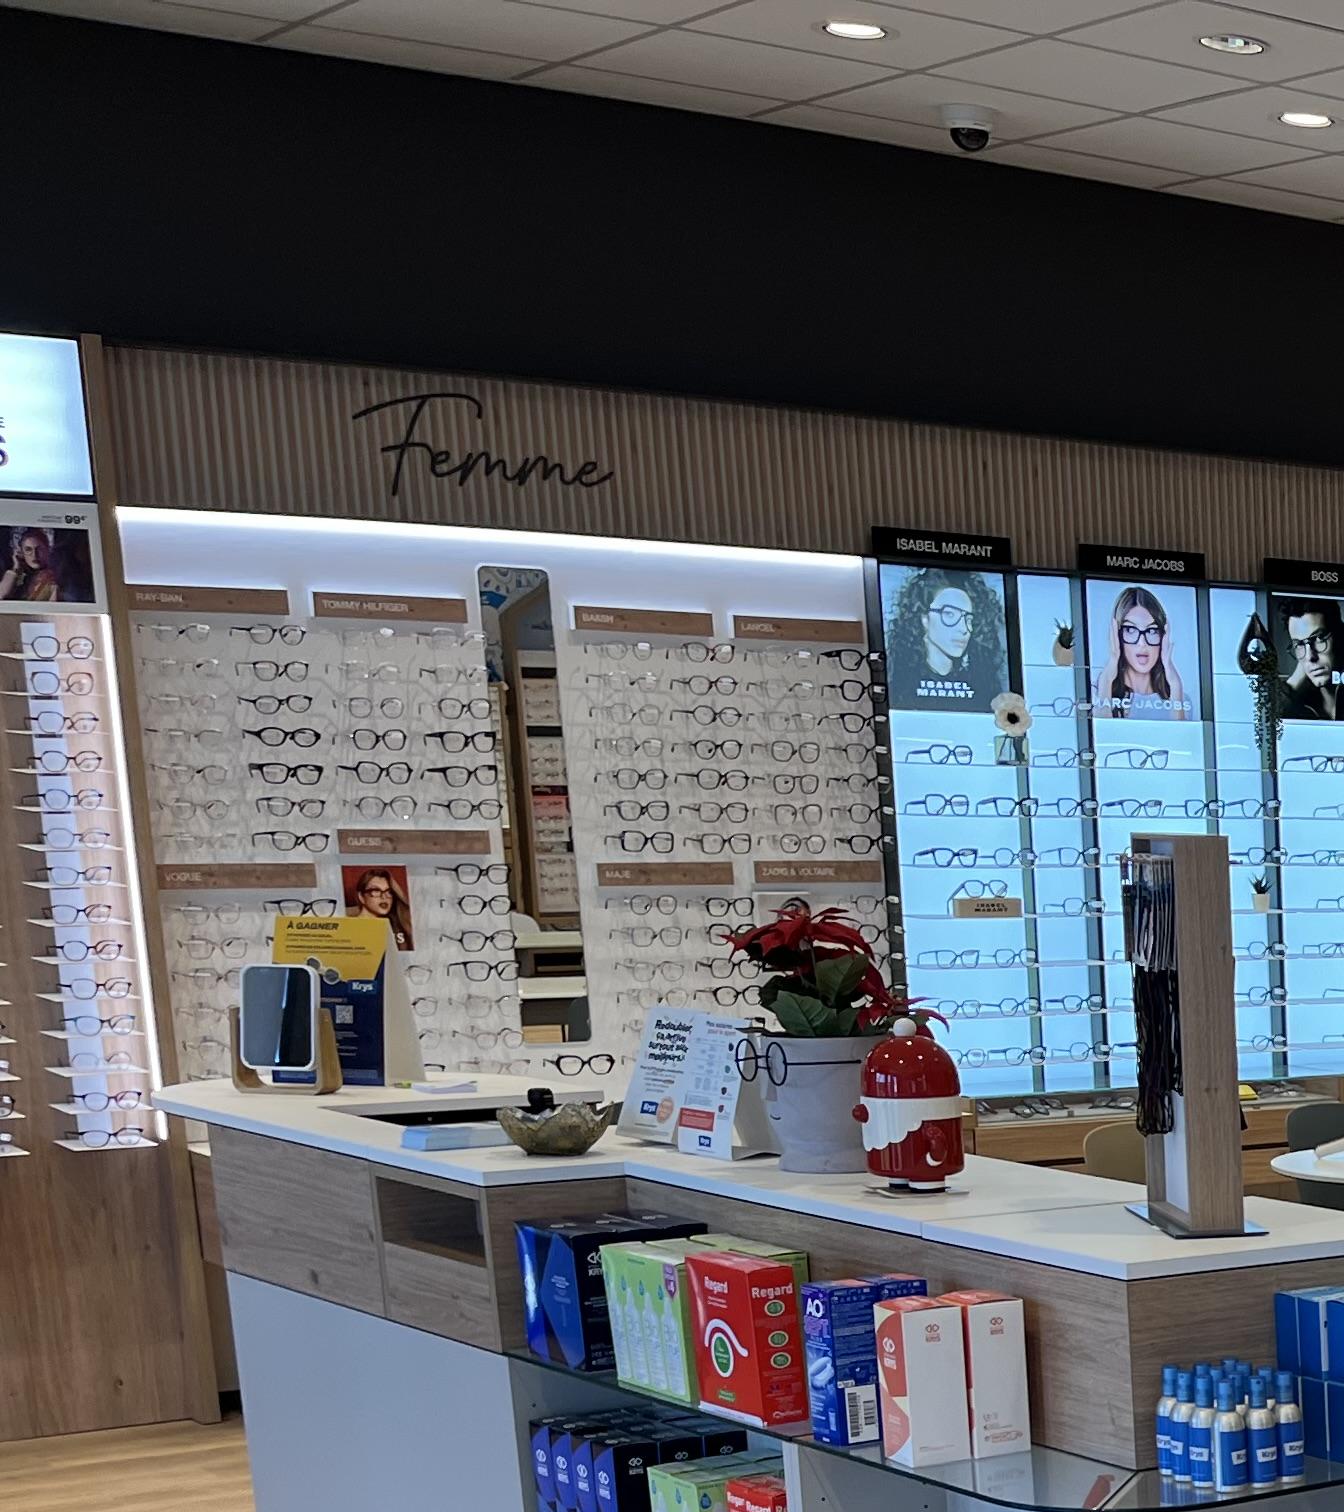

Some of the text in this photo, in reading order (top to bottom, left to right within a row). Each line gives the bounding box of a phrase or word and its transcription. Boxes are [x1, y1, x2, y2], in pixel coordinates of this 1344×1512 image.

[352, 393, 614, 496] Femme
[896, 538, 993, 558] ISABEL MARANT
[1106, 555, 1185, 572] MARC JACOBS
[1311, 571, 1339, 583] BOSS
[135, 592, 183, 604] RAY-BAN
[321, 599, 410, 613] TOMMY HILFIGER
[920, 679, 971, 691] ISABEL
[916, 688, 975, 700] MARANT
[1135, 699, 1192, 711] JACOBS
[165, 872, 201, 882] VOGUE
[605, 870, 631, 879] MAJE
[296, 922, 339, 931] GAGNER
[352, 982, 374, 993] Krys
[704, 1276, 728, 1295] Regard
[751, 1283, 794, 1299] Regard
[805, 1297, 823, 1317] AO
